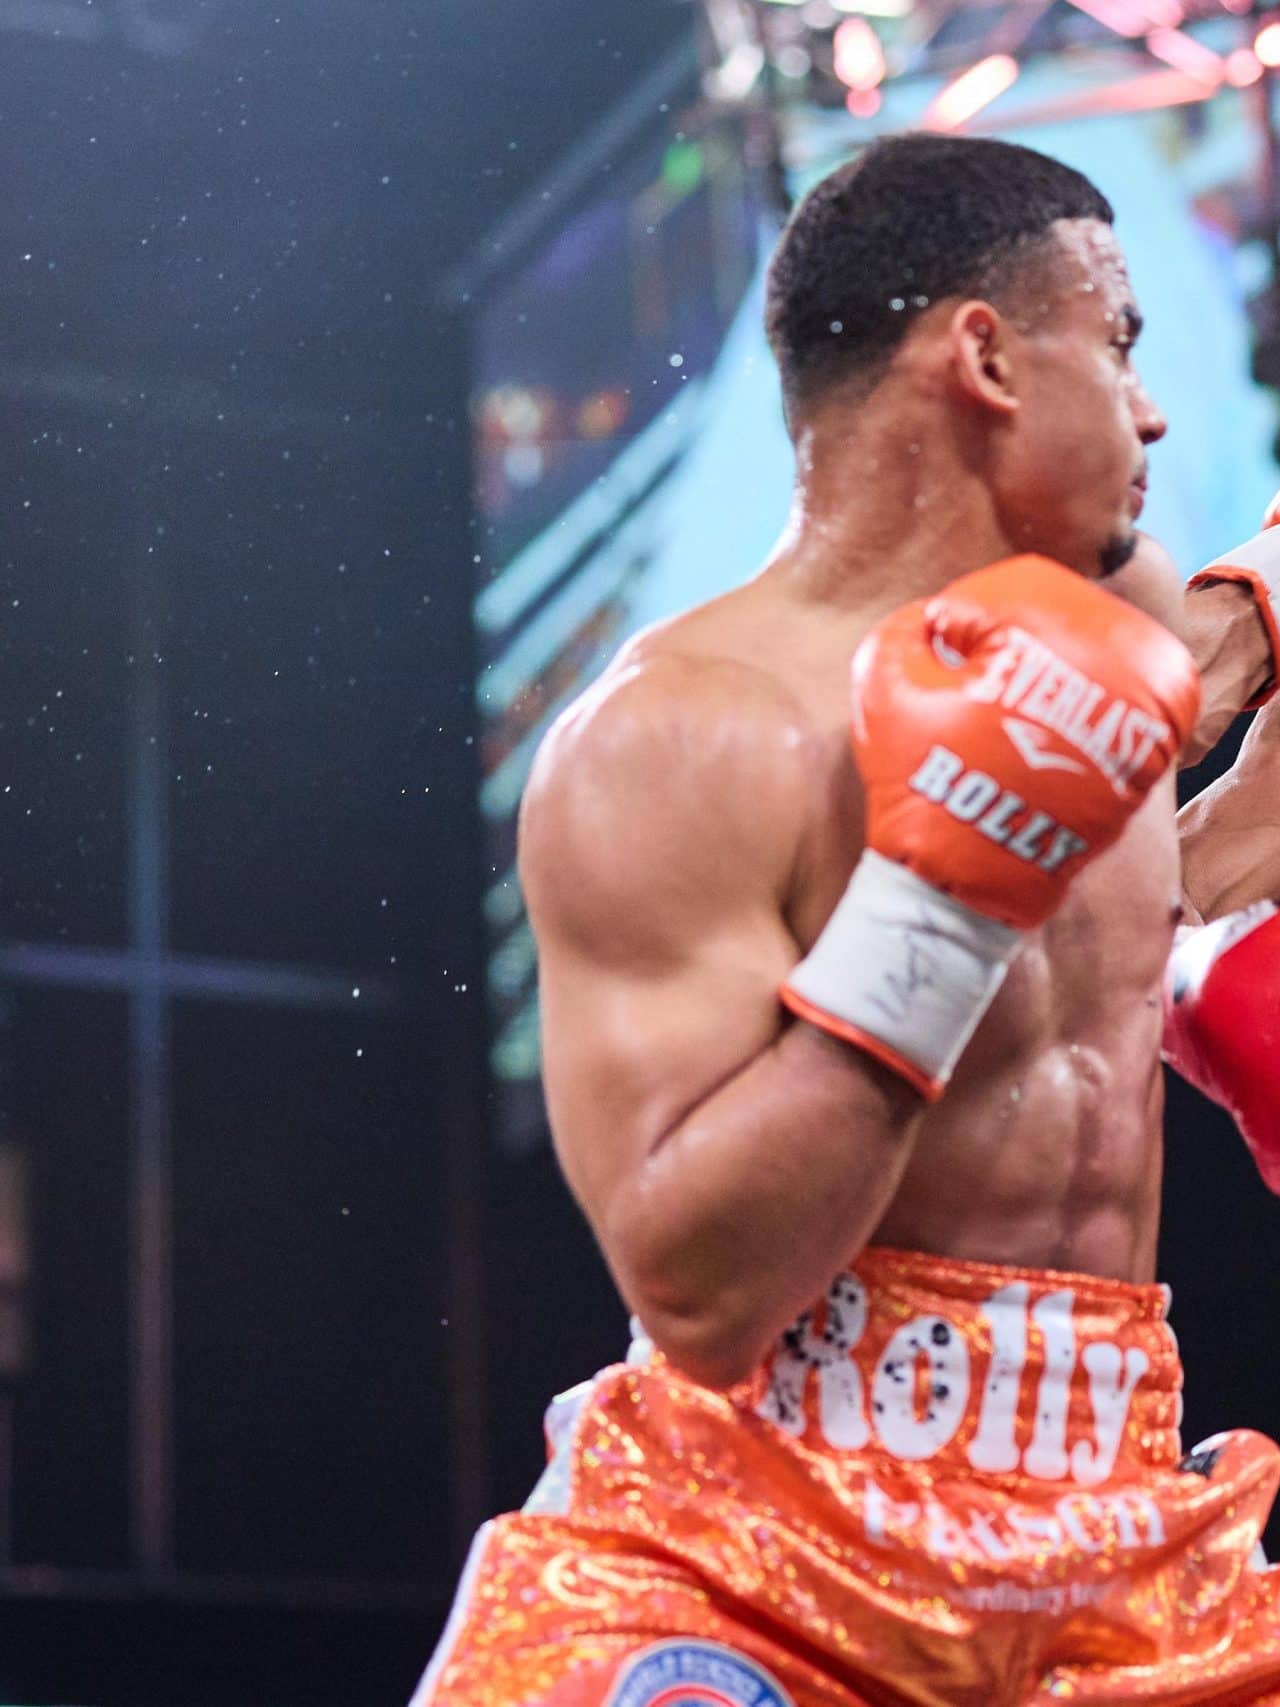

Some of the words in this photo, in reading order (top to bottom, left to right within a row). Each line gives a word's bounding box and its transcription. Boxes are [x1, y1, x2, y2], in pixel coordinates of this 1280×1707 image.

[966, 627, 1172, 799] EVERLAST
[909, 744, 1088, 874] ROLLY
[755, 1269, 1150, 1486] Rolly
